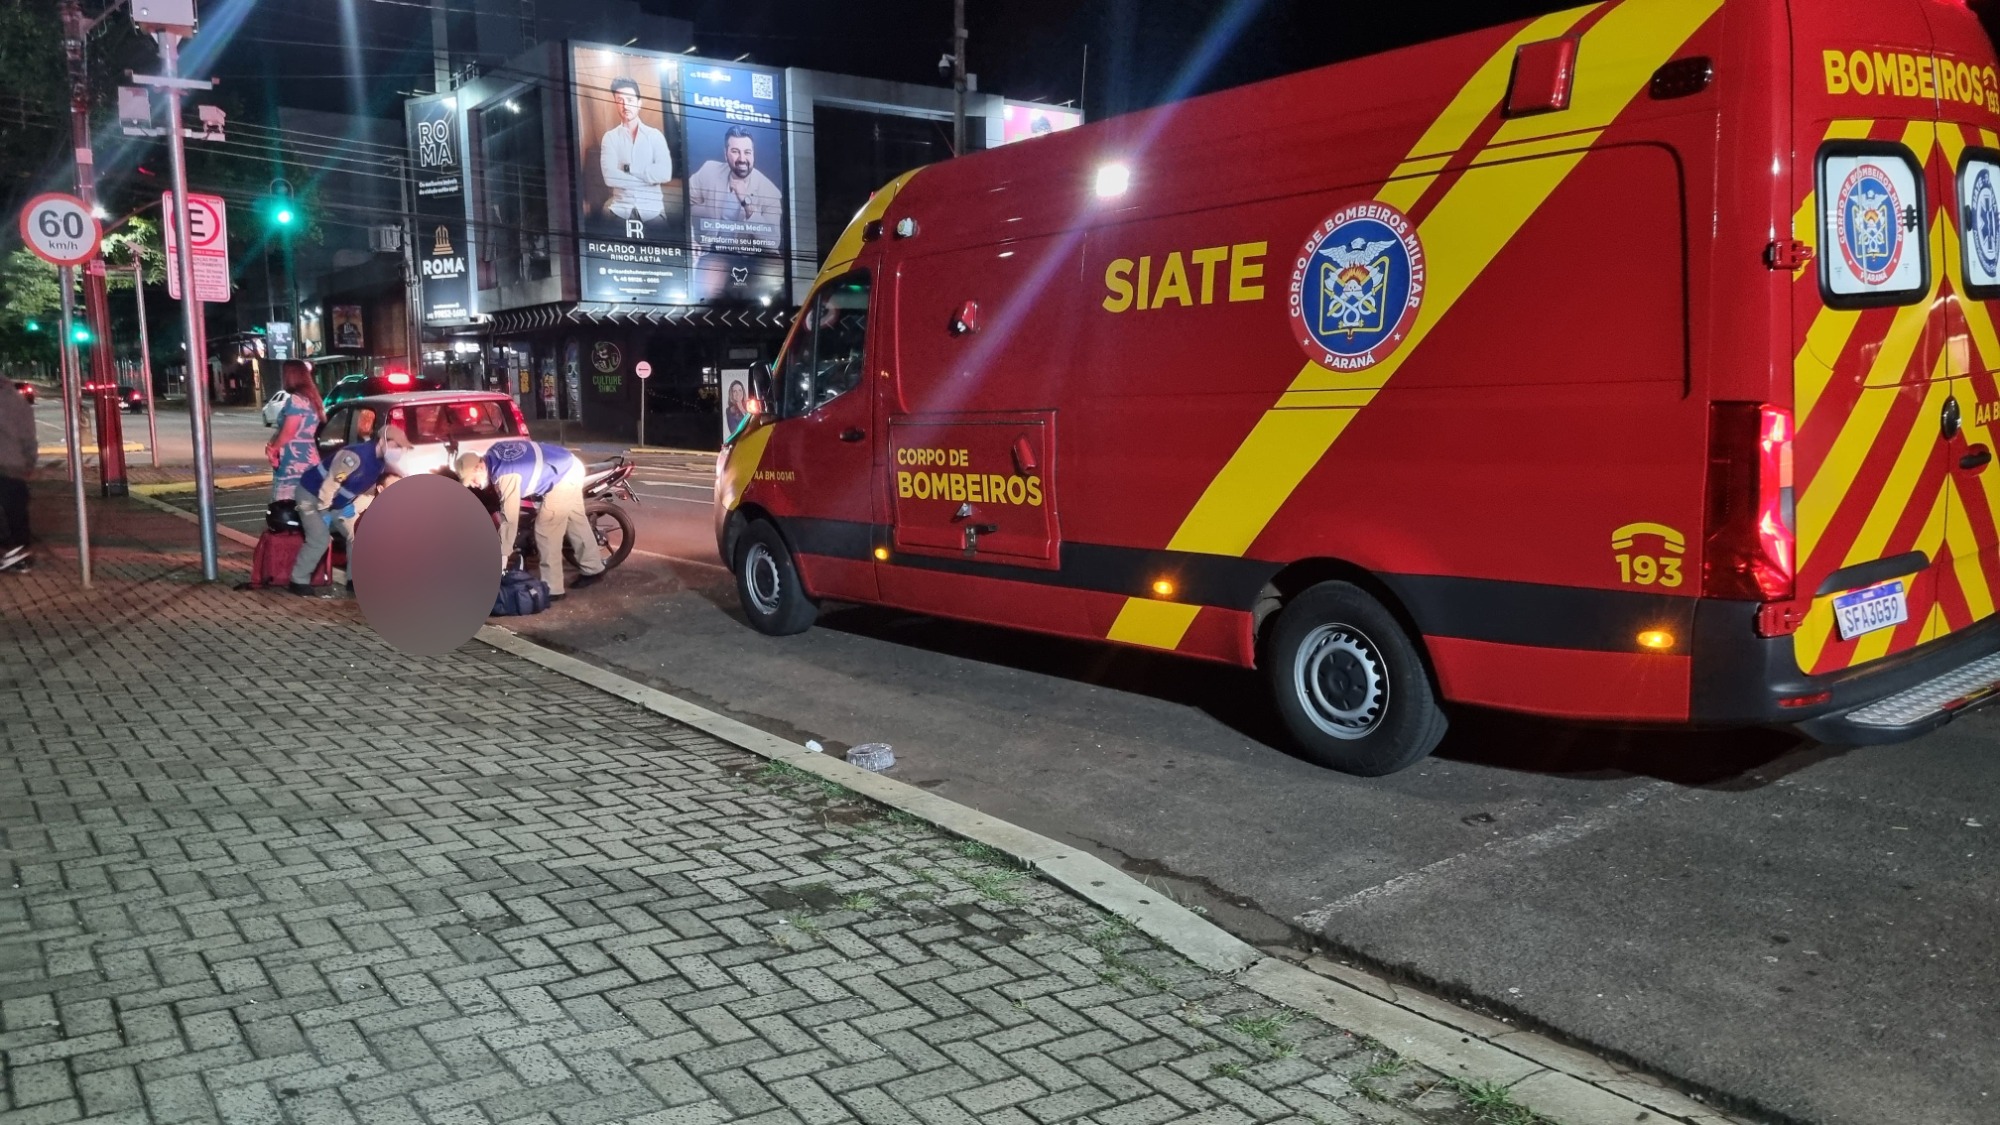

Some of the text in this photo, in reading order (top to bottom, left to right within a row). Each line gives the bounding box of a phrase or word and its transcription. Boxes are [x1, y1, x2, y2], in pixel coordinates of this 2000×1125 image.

[1823, 50, 1983, 105] BOMBEIROS
[694, 92, 740, 110] Lentes
[1986, 89, 2000, 114] 193
[1837, 200, 1845, 244] CORPO
[1842, 182, 1851, 198] DE
[1891, 192, 1903, 242] MILITAR
[39, 210, 83, 239] 60
[703, 221, 772, 232] Dr. Douglas Medina
[48, 240, 78, 250] km/h
[588, 243, 682, 256] RICARDO HÜBNER
[701, 235, 739, 245] Transforme
[422, 257, 465, 276] ROMA
[610, 253, 662, 263] RINOPLASTIA
[1290, 205, 1424, 318] CORPO DE BOMBEIROS MILITAR
[1102, 241, 1268, 313] SIATE
[1324, 351, 1375, 369] PARANÁ
[592, 375, 623, 385] CULTURE
[1976, 404, 1991, 425] AA
[897, 448, 969, 467] CORPO DE
[754, 470, 764, 480] AA
[765, 470, 775, 480] BM
[897, 471, 1043, 507] BOMBEIROS
[1615, 553, 1684, 588] 193
[1844, 596, 1899, 632] SFA3G59
